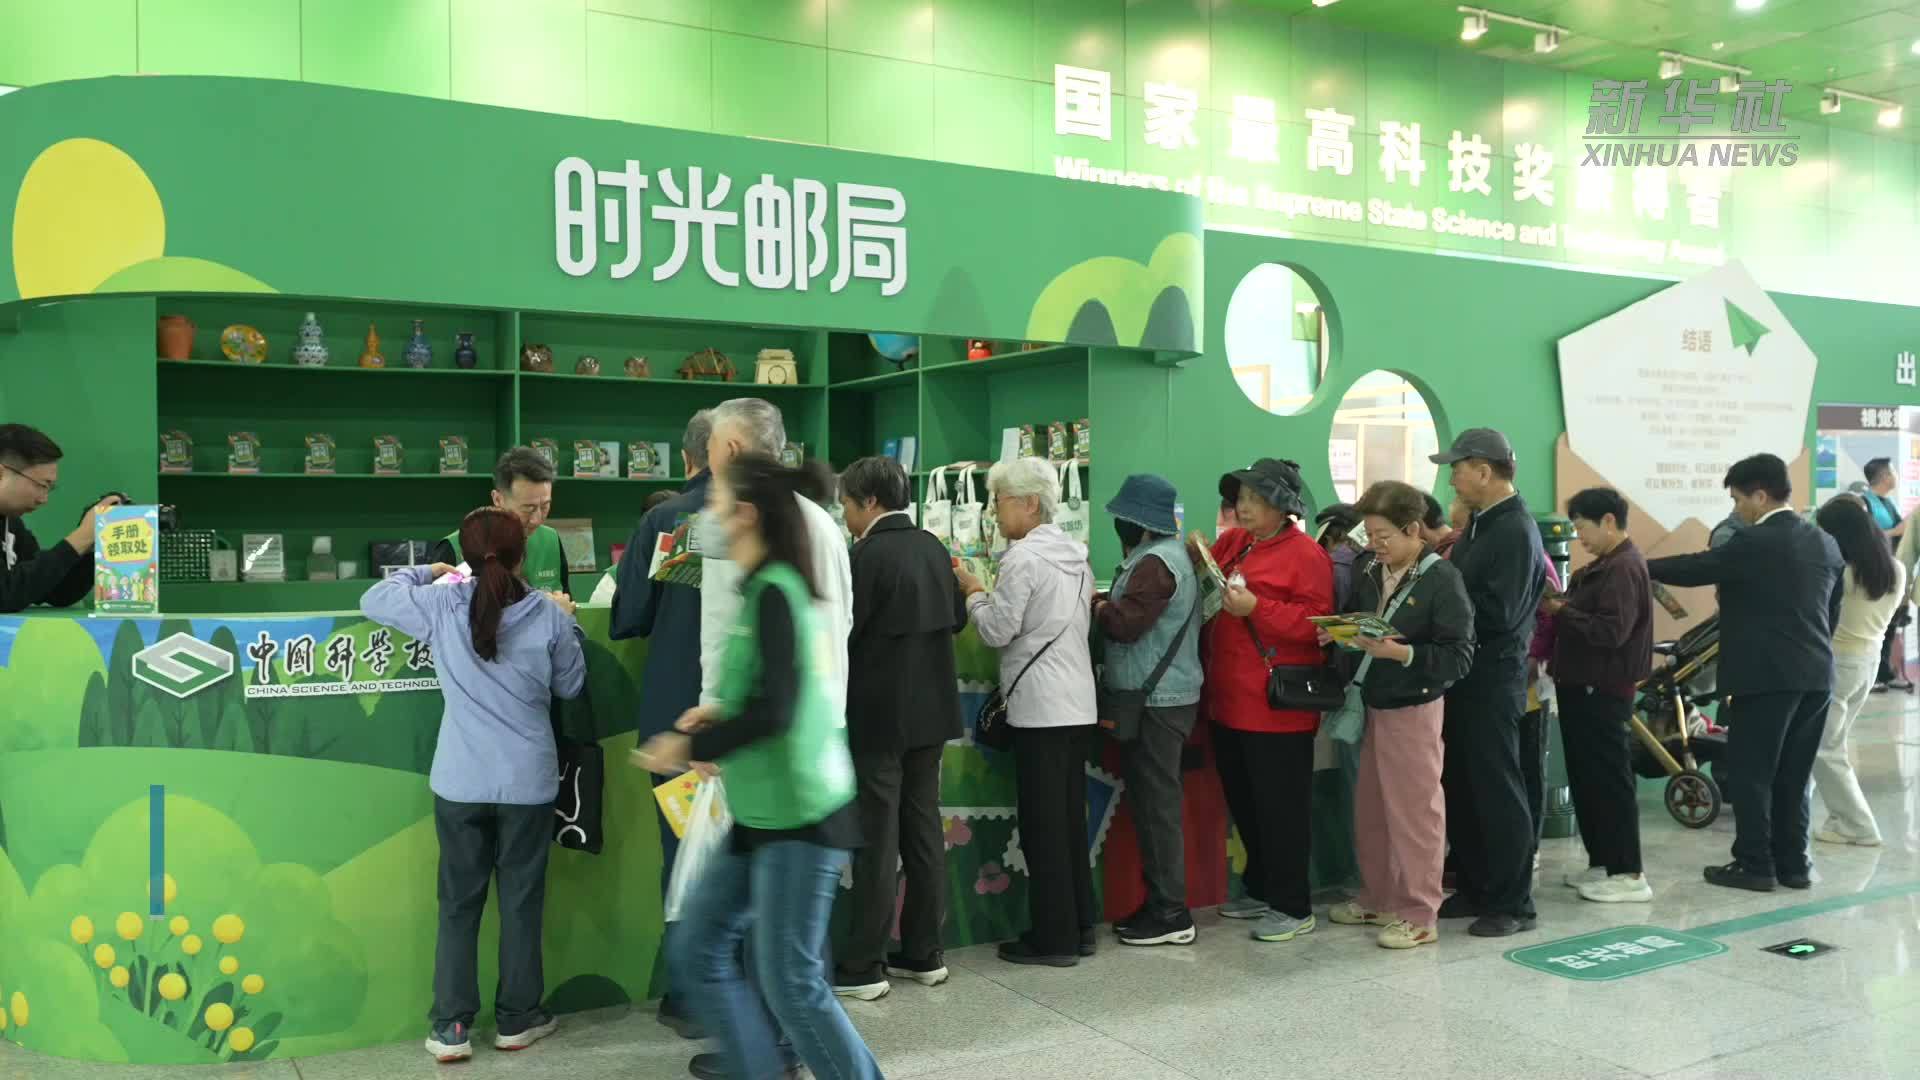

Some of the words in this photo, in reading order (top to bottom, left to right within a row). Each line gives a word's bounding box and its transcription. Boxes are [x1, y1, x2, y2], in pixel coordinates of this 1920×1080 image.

[1056, 156, 1169, 192] Winners
[1367, 198, 1427, 231] State
[1432, 208, 1516, 241] Science
[1519, 223, 1556, 247] and
[554, 156, 907, 297] 时光邮局
[1896, 351, 1916, 386] 出
[112, 524, 139, 539] 手册
[107, 540, 148, 556] 领取处
[247, 686, 288, 696] CHINA
[292, 684, 346, 694] SCIENCE
[351, 682, 377, 691] AND
